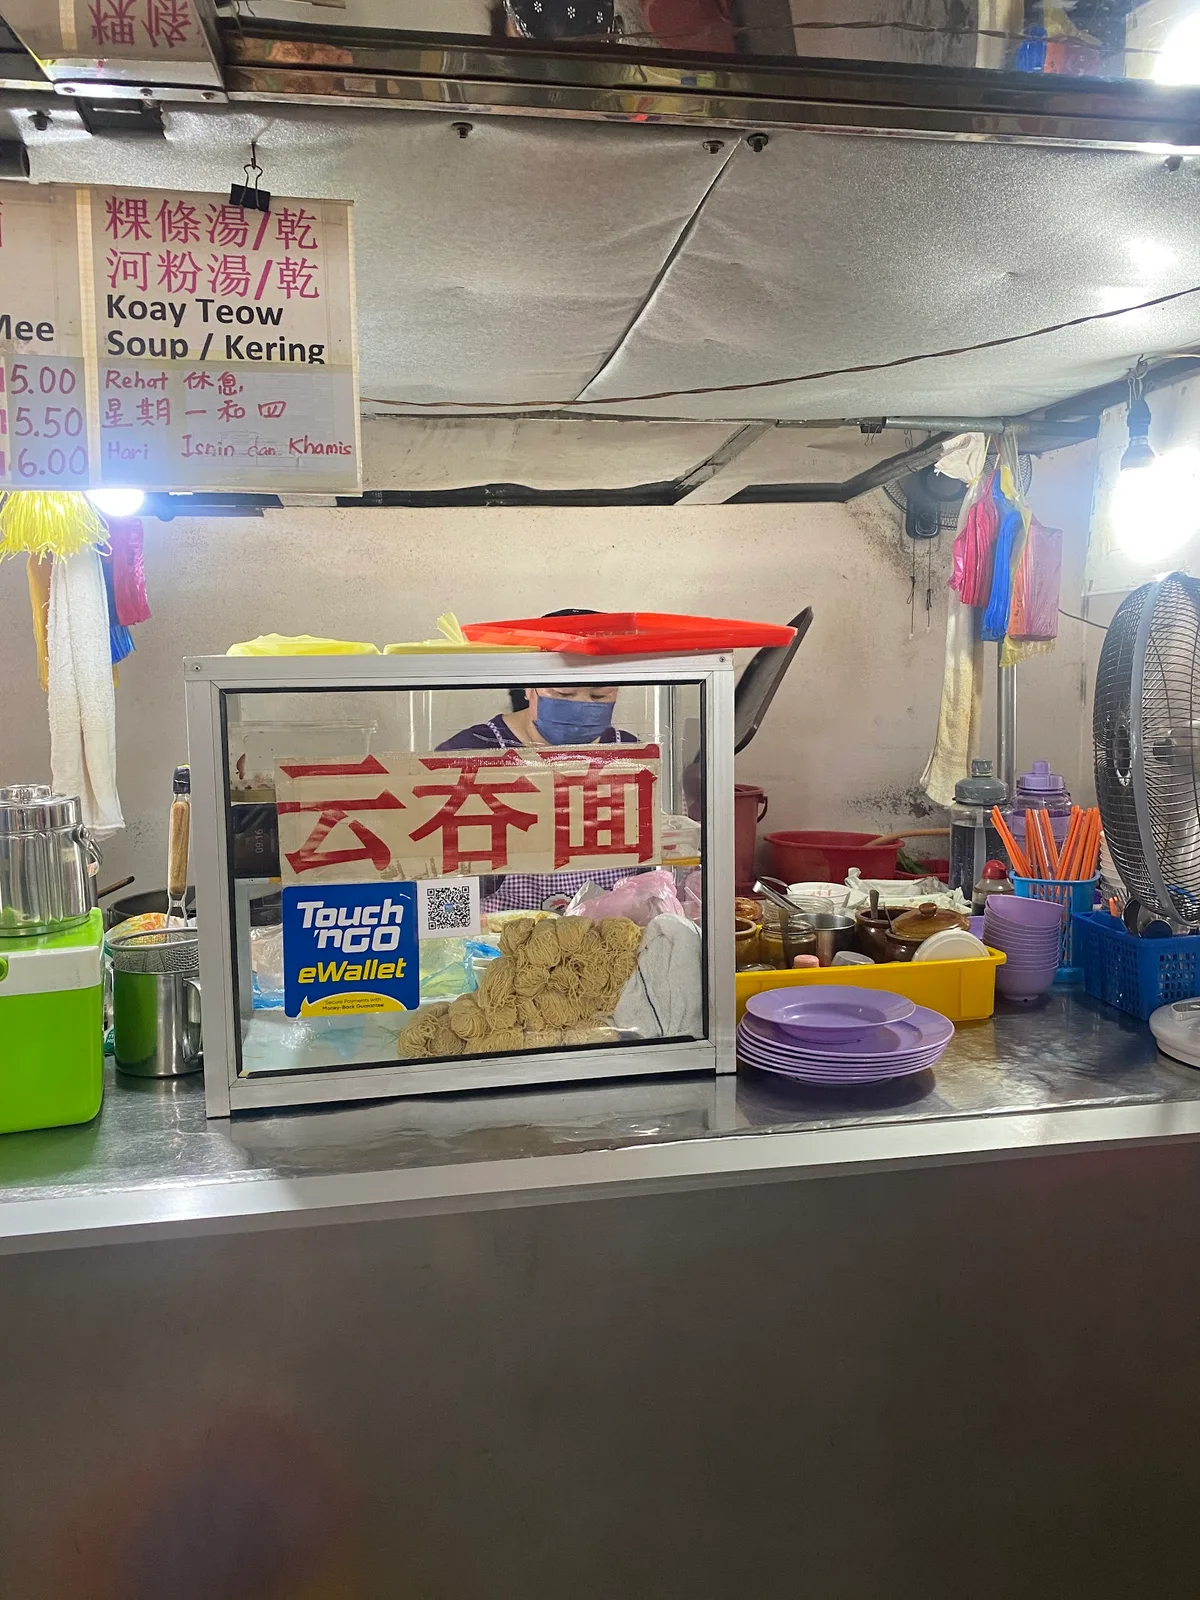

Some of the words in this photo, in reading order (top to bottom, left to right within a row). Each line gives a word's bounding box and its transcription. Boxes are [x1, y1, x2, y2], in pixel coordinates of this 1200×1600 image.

[106, 196, 319, 250] 粿條湯/乾
[105, 248, 320, 301] 河粉湯/乾
[107, 294, 187, 327] Koay
[196, 298, 284, 326] Teow
[107, 330, 189, 360] Soup
[225, 335, 325, 365] Kering
[10, 364, 76, 395] 5.00
[105, 370, 169, 390] Rehat
[15, 407, 83, 438] 5.50
[18, 446, 88, 477] 6.00
[107, 441, 149, 461] Hari
[182, 434, 235, 458] Isnin
[247, 436, 277, 457] dan
[288, 435, 352, 457] Khamis
[277, 743, 659, 875] 云吞面
[297, 898, 404, 929] Touch
[297, 957, 407, 984] eWallet
